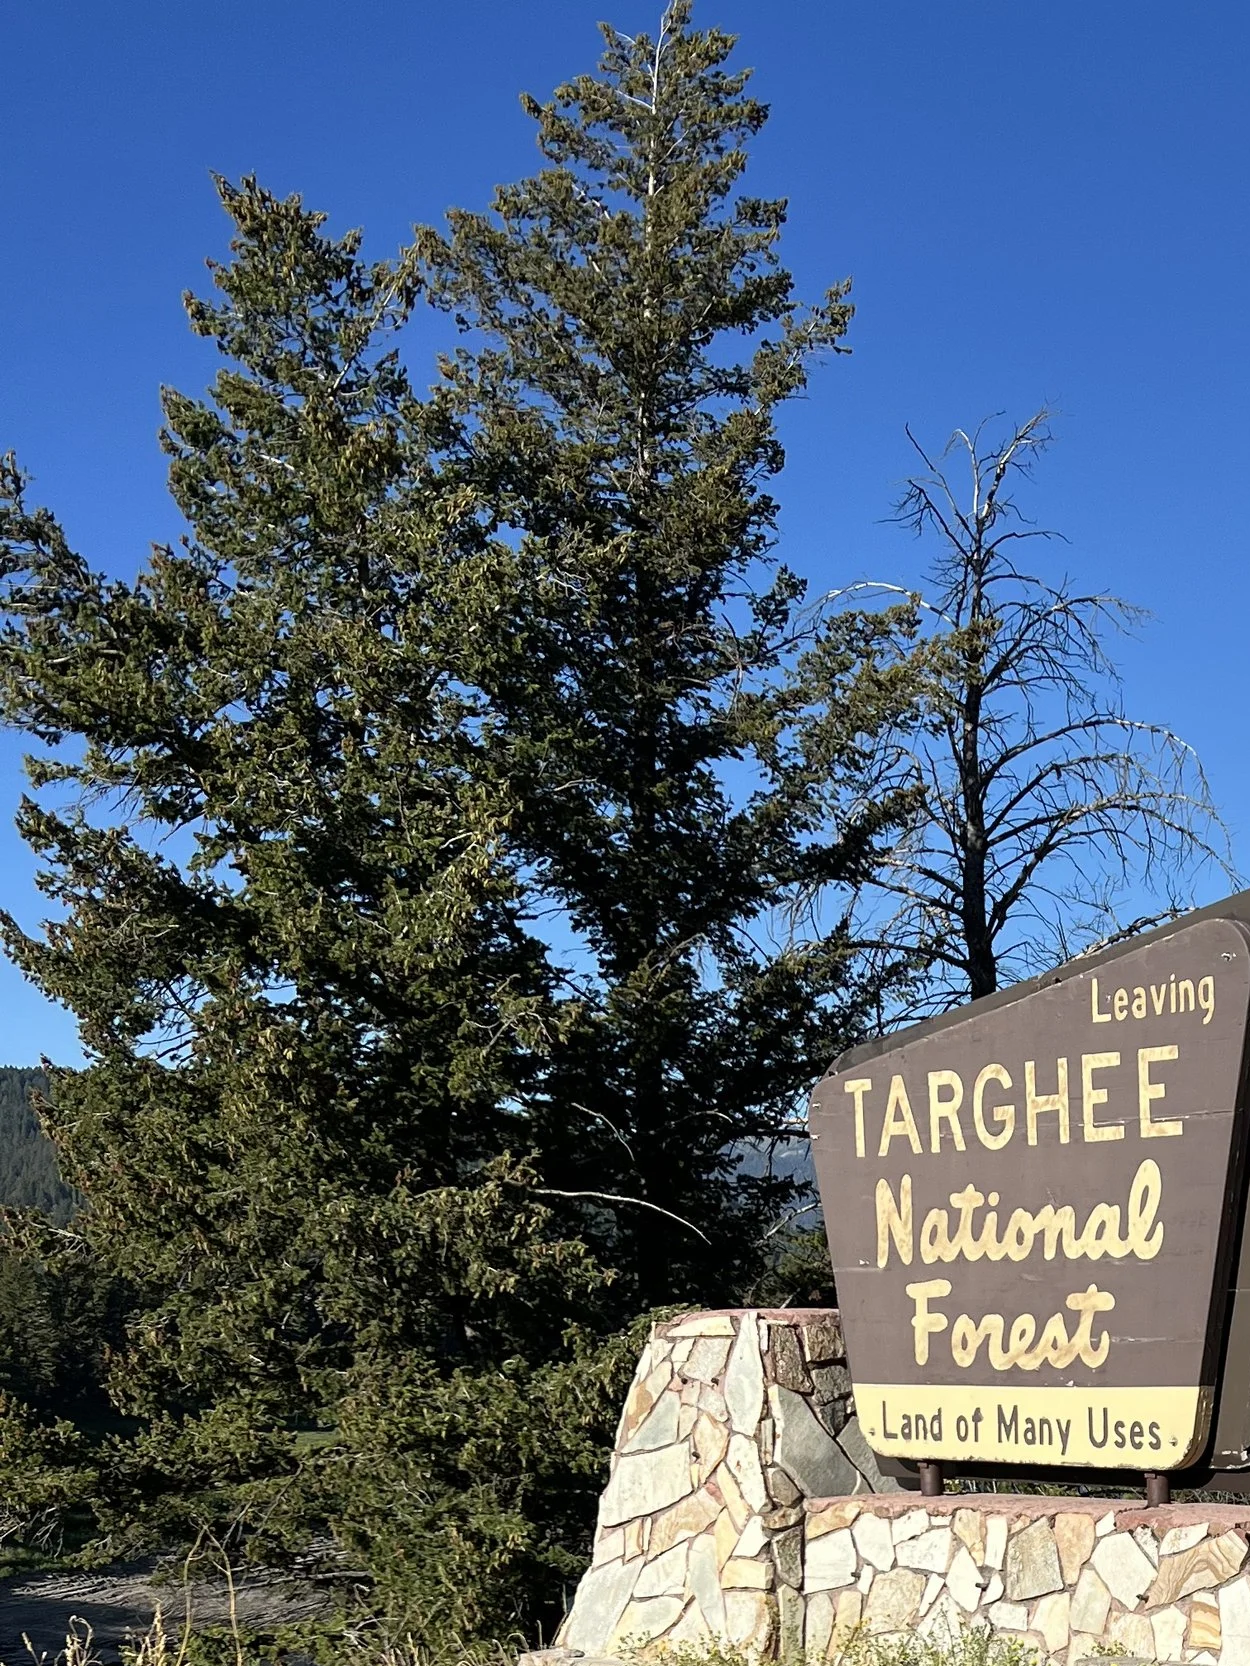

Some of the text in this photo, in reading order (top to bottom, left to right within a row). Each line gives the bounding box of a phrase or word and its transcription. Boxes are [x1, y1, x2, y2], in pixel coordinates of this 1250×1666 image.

[1090, 974, 1216, 1024] Leaving
[843, 1044, 1184, 1158] TARGHEE
[875, 1158, 1165, 1269] National
[904, 1278, 1116, 1371] Forest
[882, 1401, 1162, 1455] Land of Many Uses
